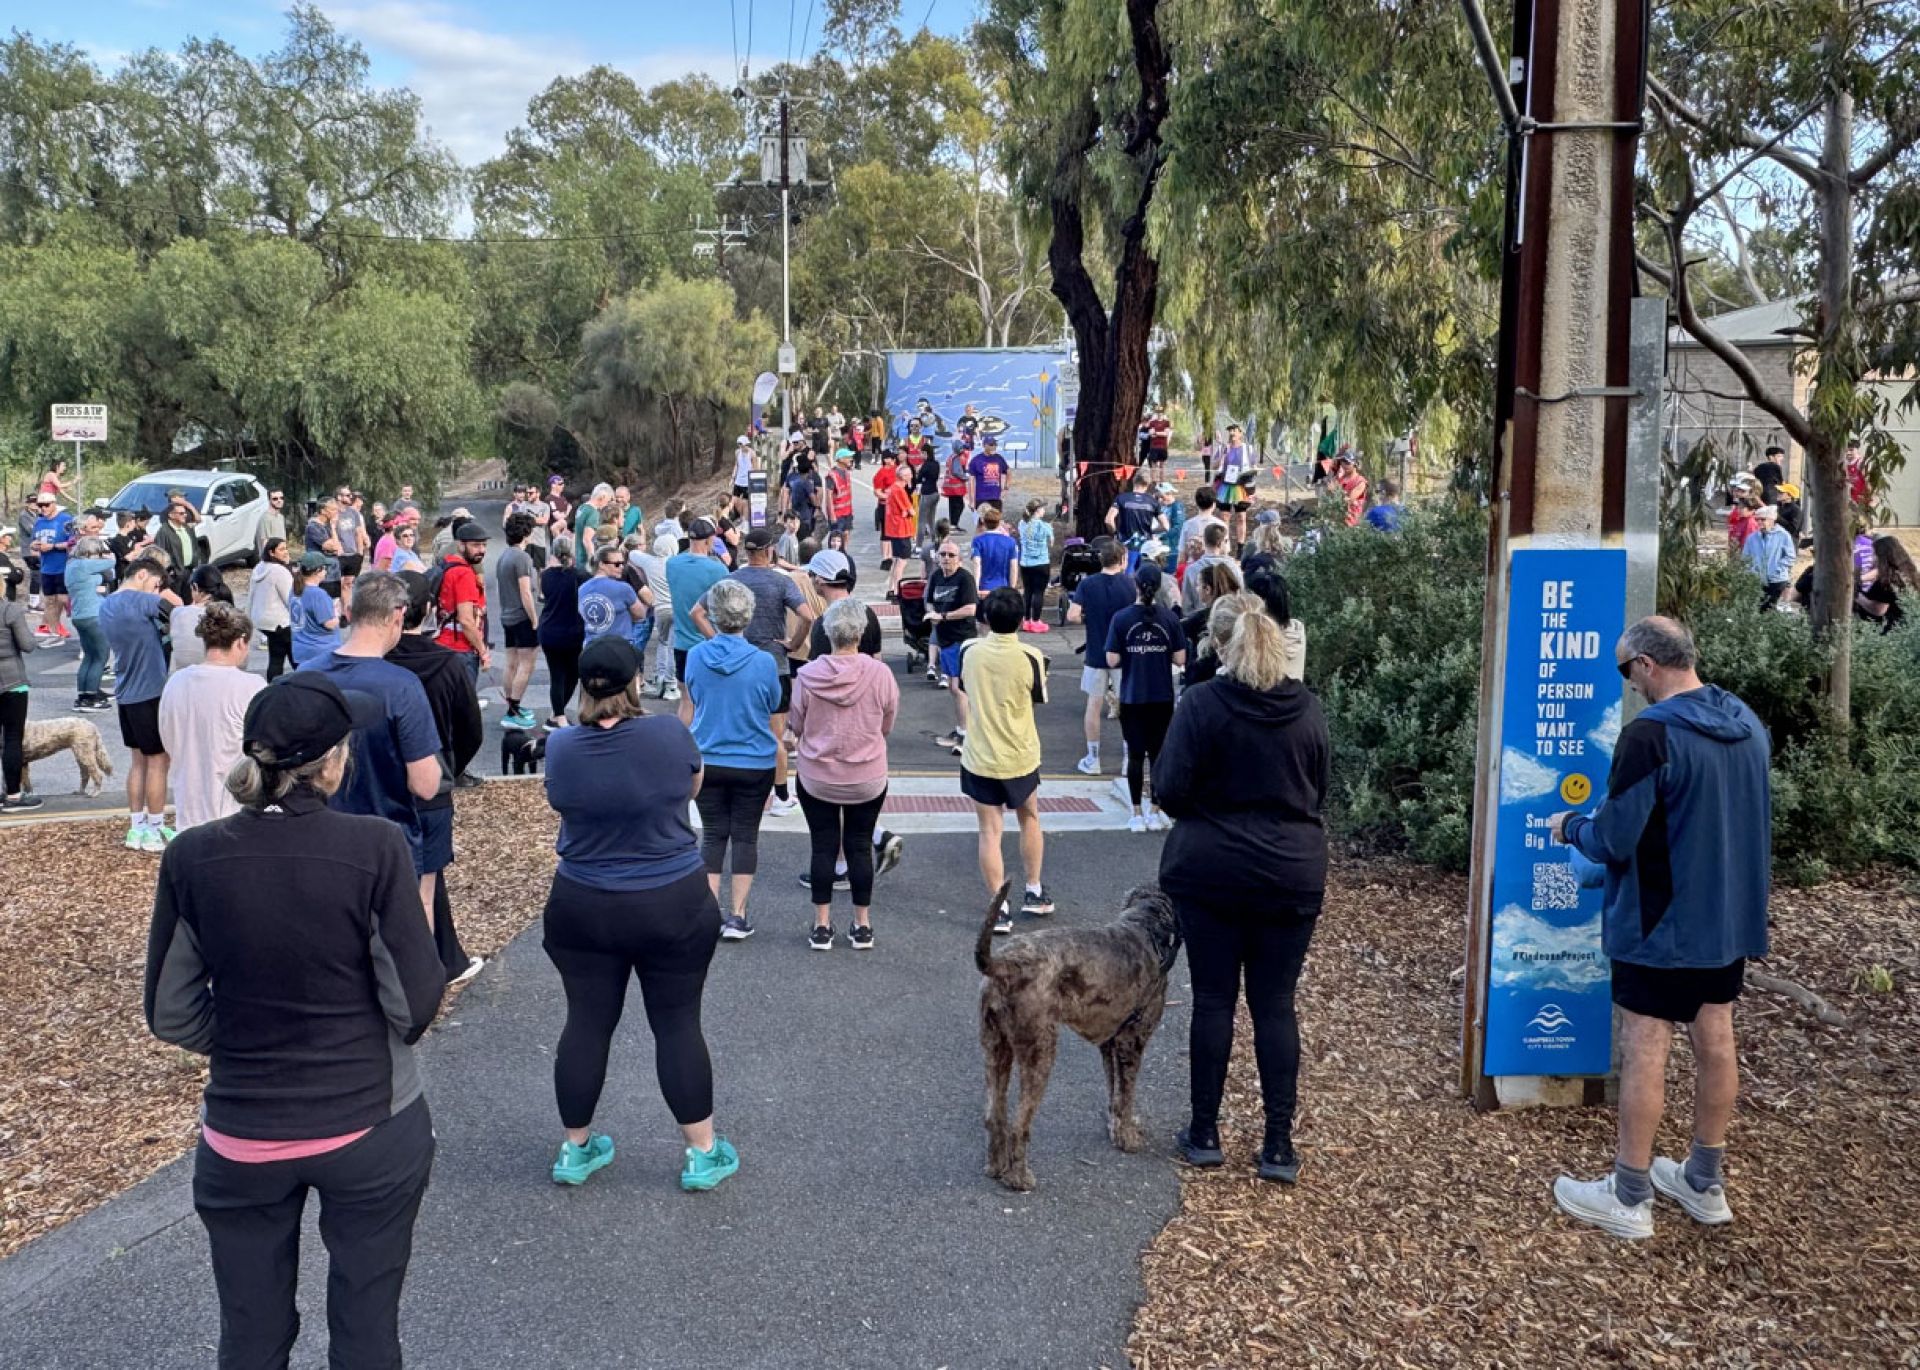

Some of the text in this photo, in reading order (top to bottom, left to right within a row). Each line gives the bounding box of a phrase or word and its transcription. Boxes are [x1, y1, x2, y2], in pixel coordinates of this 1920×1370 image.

[1542, 580, 1574, 609] BE
[1541, 612, 1567, 628] THE
[1539, 631, 1600, 660] KIND
[1539, 662, 1557, 678] OF
[1537, 683, 1594, 699] PERSON
[1537, 703, 1565, 719] YOU
[1536, 722, 1576, 738] WANT
[1536, 740, 1585, 755] TO SEE
[1525, 833, 1545, 850] Big
[1611, 1207, 1642, 1221] HOKA
